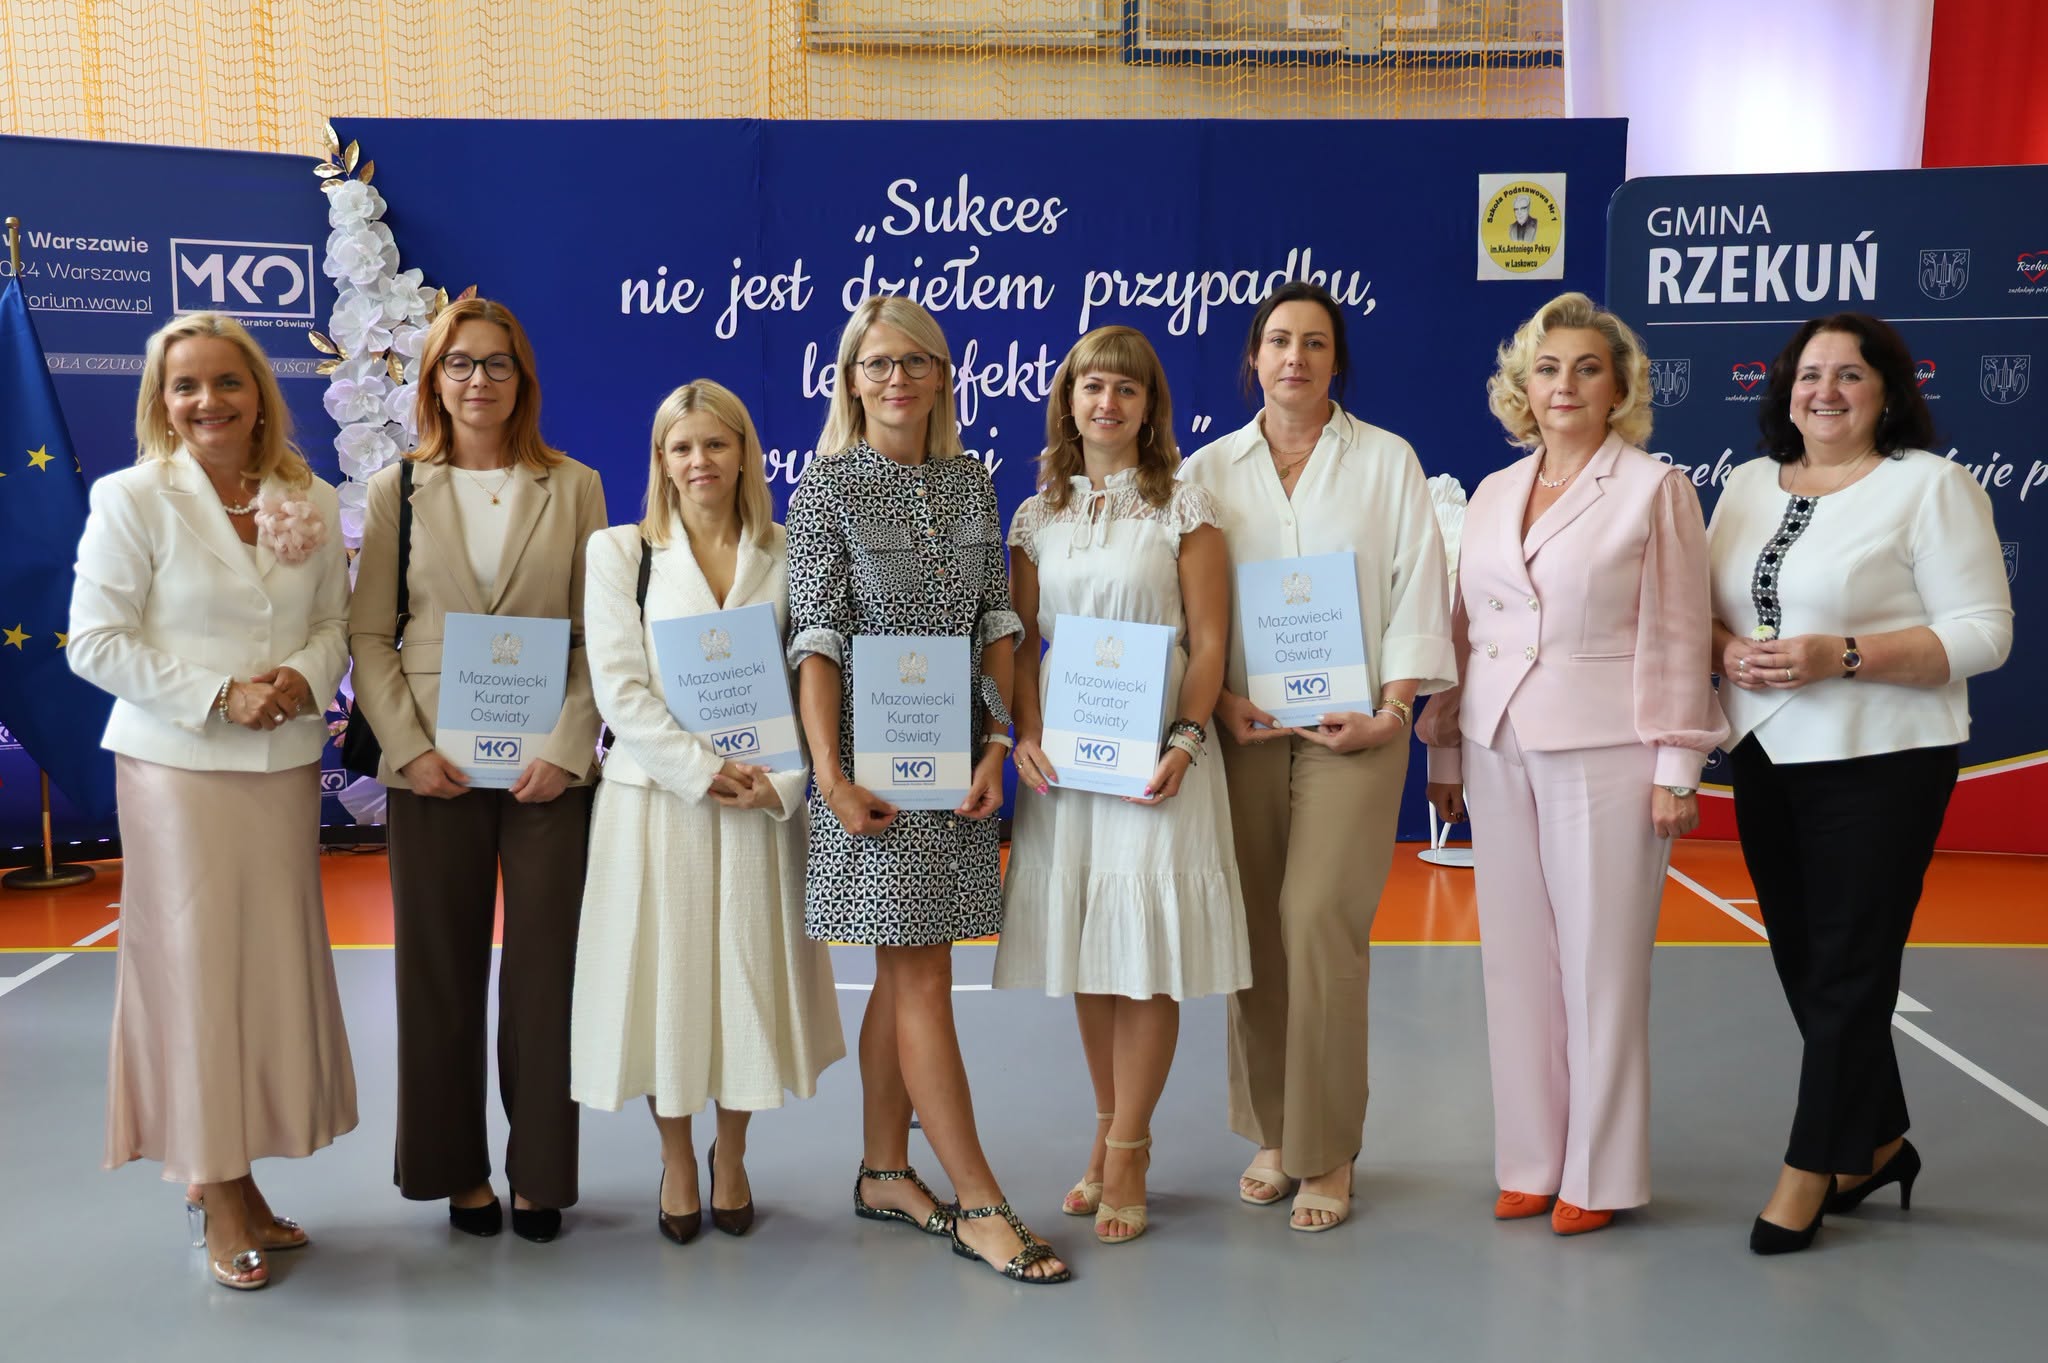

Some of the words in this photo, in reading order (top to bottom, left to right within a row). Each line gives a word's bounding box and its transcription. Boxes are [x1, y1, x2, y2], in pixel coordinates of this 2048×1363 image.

[1487, 197, 1504, 223] Szkoła
[1503, 186, 1549, 203] Podstawowa
[1548, 204, 1555, 215] Nr
[1647, 204, 1772, 237] GMINA
[28, 231, 149, 253] Warszawie
[47, 262, 151, 283] Warszawa
[1511, 259, 1538, 268] Laskowcu
[1648, 230, 1879, 305] RZEKUŃ
[181, 253, 305, 306] MKO
[24, 292, 152, 314] orium.waw.pl
[621, 265, 704, 314] nie
[715, 257, 814, 340] jest
[275, 319, 315, 330] Oświaty
[1258, 608, 1343, 629] Mazowiecki
[1275, 629, 1329, 645] Kurator
[1275, 647, 1332, 663] Oświaty
[459, 670, 547, 688] Mazowiecki
[678, 661, 766, 687] Mazowiecki
[1064, 671, 1147, 694] Mazowiecki
[697, 683, 753, 703] Kurator
[1288, 677, 1327, 695] MKO
[474, 690, 530, 705] Kurator
[871, 692, 955, 706] Mazowiecki
[1077, 691, 1129, 710] Kurator
[470, 708, 530, 727] Oświaty
[700, 701, 758, 721] Oświaty
[887, 711, 939, 724] Kurator
[1073, 709, 1129, 731] Oświaty
[715, 731, 755, 751] MKO
[885, 728, 941, 746] Oświaty
[478, 740, 518, 757] MKO
[1079, 743, 1116, 762] MKO
[895, 761, 933, 778] MKO
